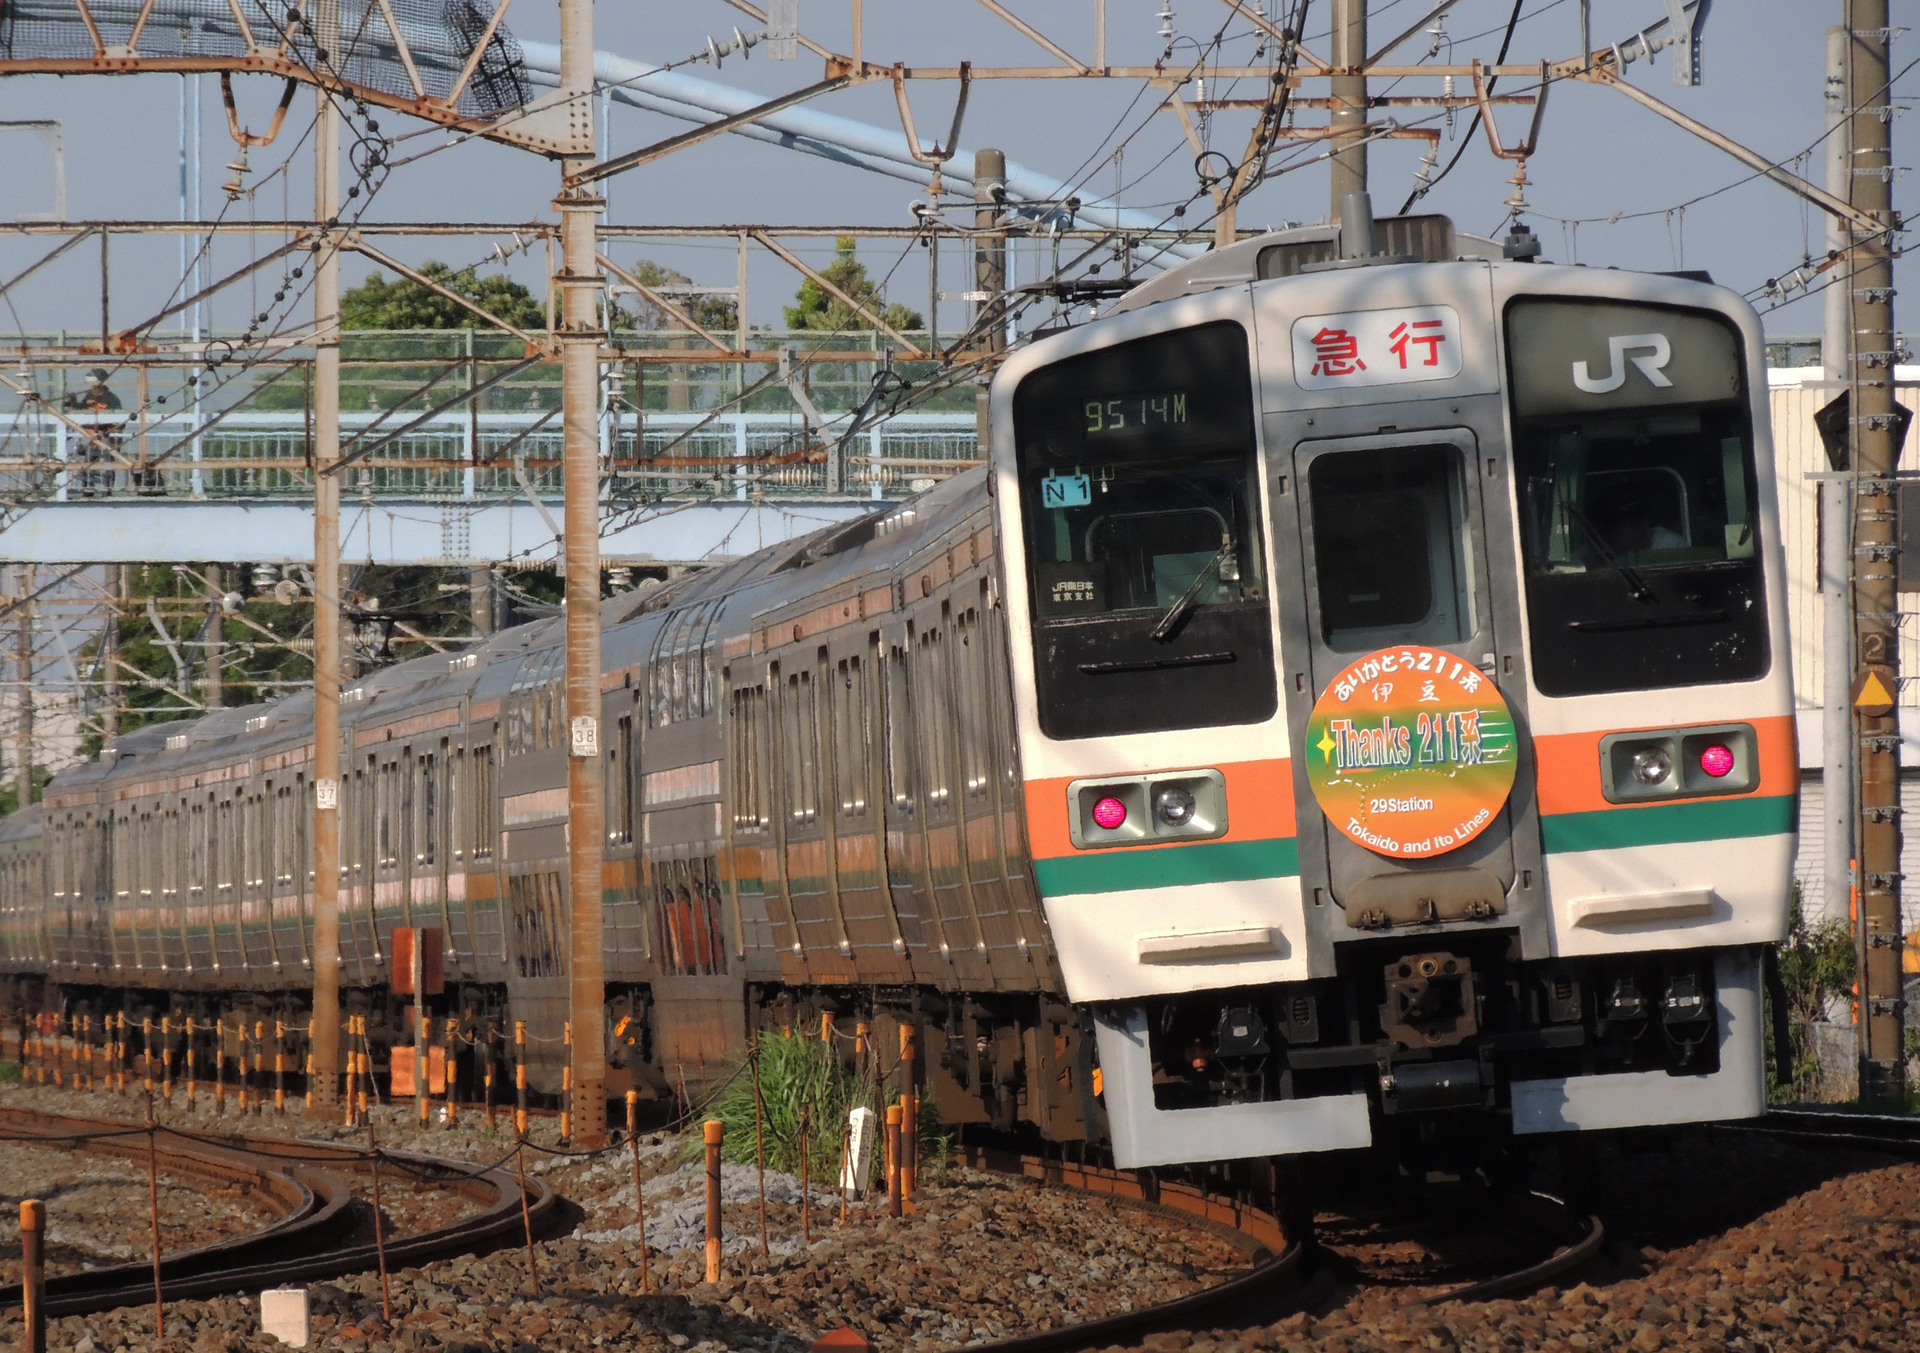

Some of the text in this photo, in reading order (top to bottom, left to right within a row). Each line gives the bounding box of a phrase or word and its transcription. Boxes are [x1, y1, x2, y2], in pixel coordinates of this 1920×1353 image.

[1310, 319, 1446, 377] 急行
[1572, 333, 1673, 394] JR
[1085, 393, 1186, 432] 9514M
[1052, 581, 1094, 592] JR東日本
[1052, 591, 1094, 603] 東京支社
[1864, 634, 1883, 659] 2
[1333, 651, 1483, 703] ありがとう211系
[1371, 680, 1441, 703] 伊豆
[575, 730, 594, 743] 38
[1331, 708, 1484, 768] Thanks 211系
[319, 788, 334, 799] 37
[1370, 797, 1434, 814] 29Station
[1346, 807, 1490, 854] Tokaido and Ito Lines
